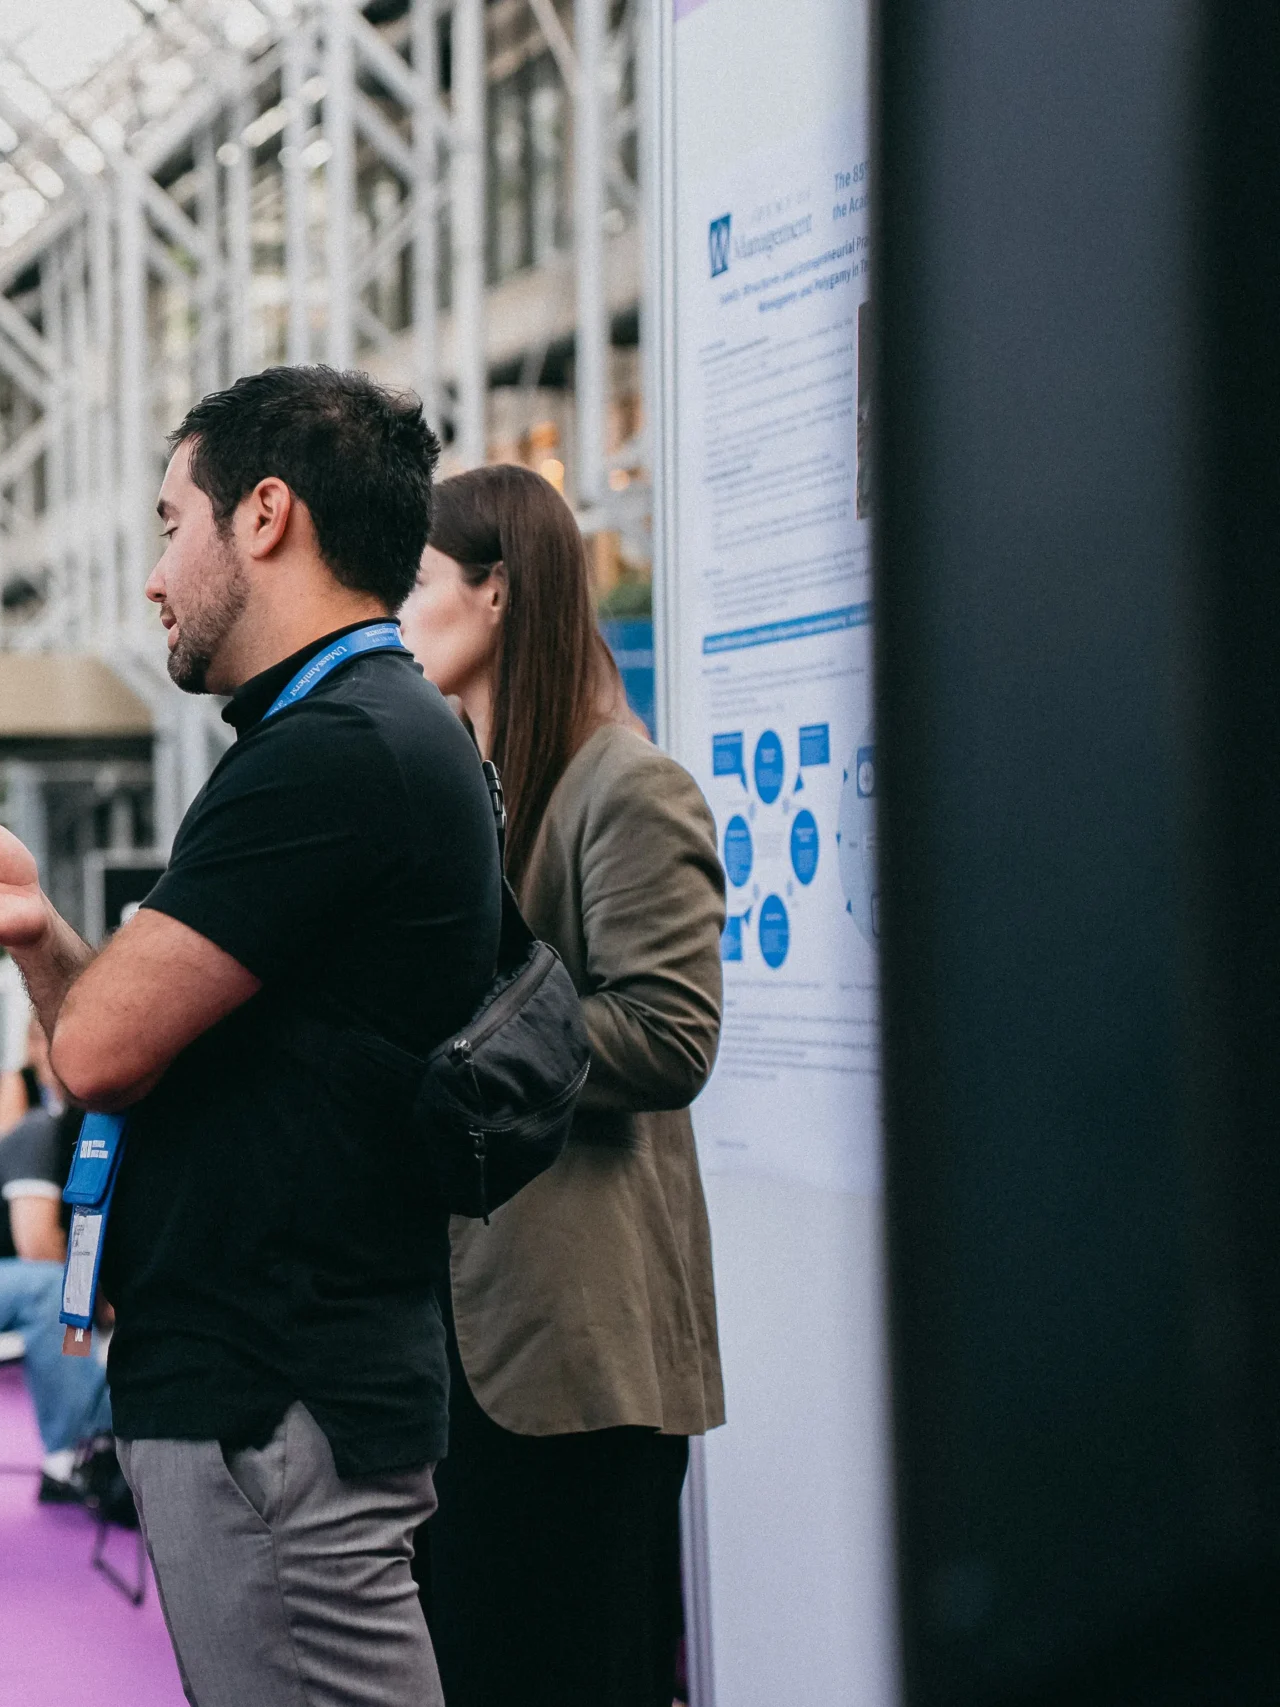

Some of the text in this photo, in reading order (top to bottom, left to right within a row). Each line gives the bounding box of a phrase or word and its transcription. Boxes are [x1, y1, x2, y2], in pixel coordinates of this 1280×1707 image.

[834, 171, 851, 191] The
[832, 204, 848, 220] the
[849, 195, 869, 215] Aca
[290, 645, 348, 697] UMassAmherst
